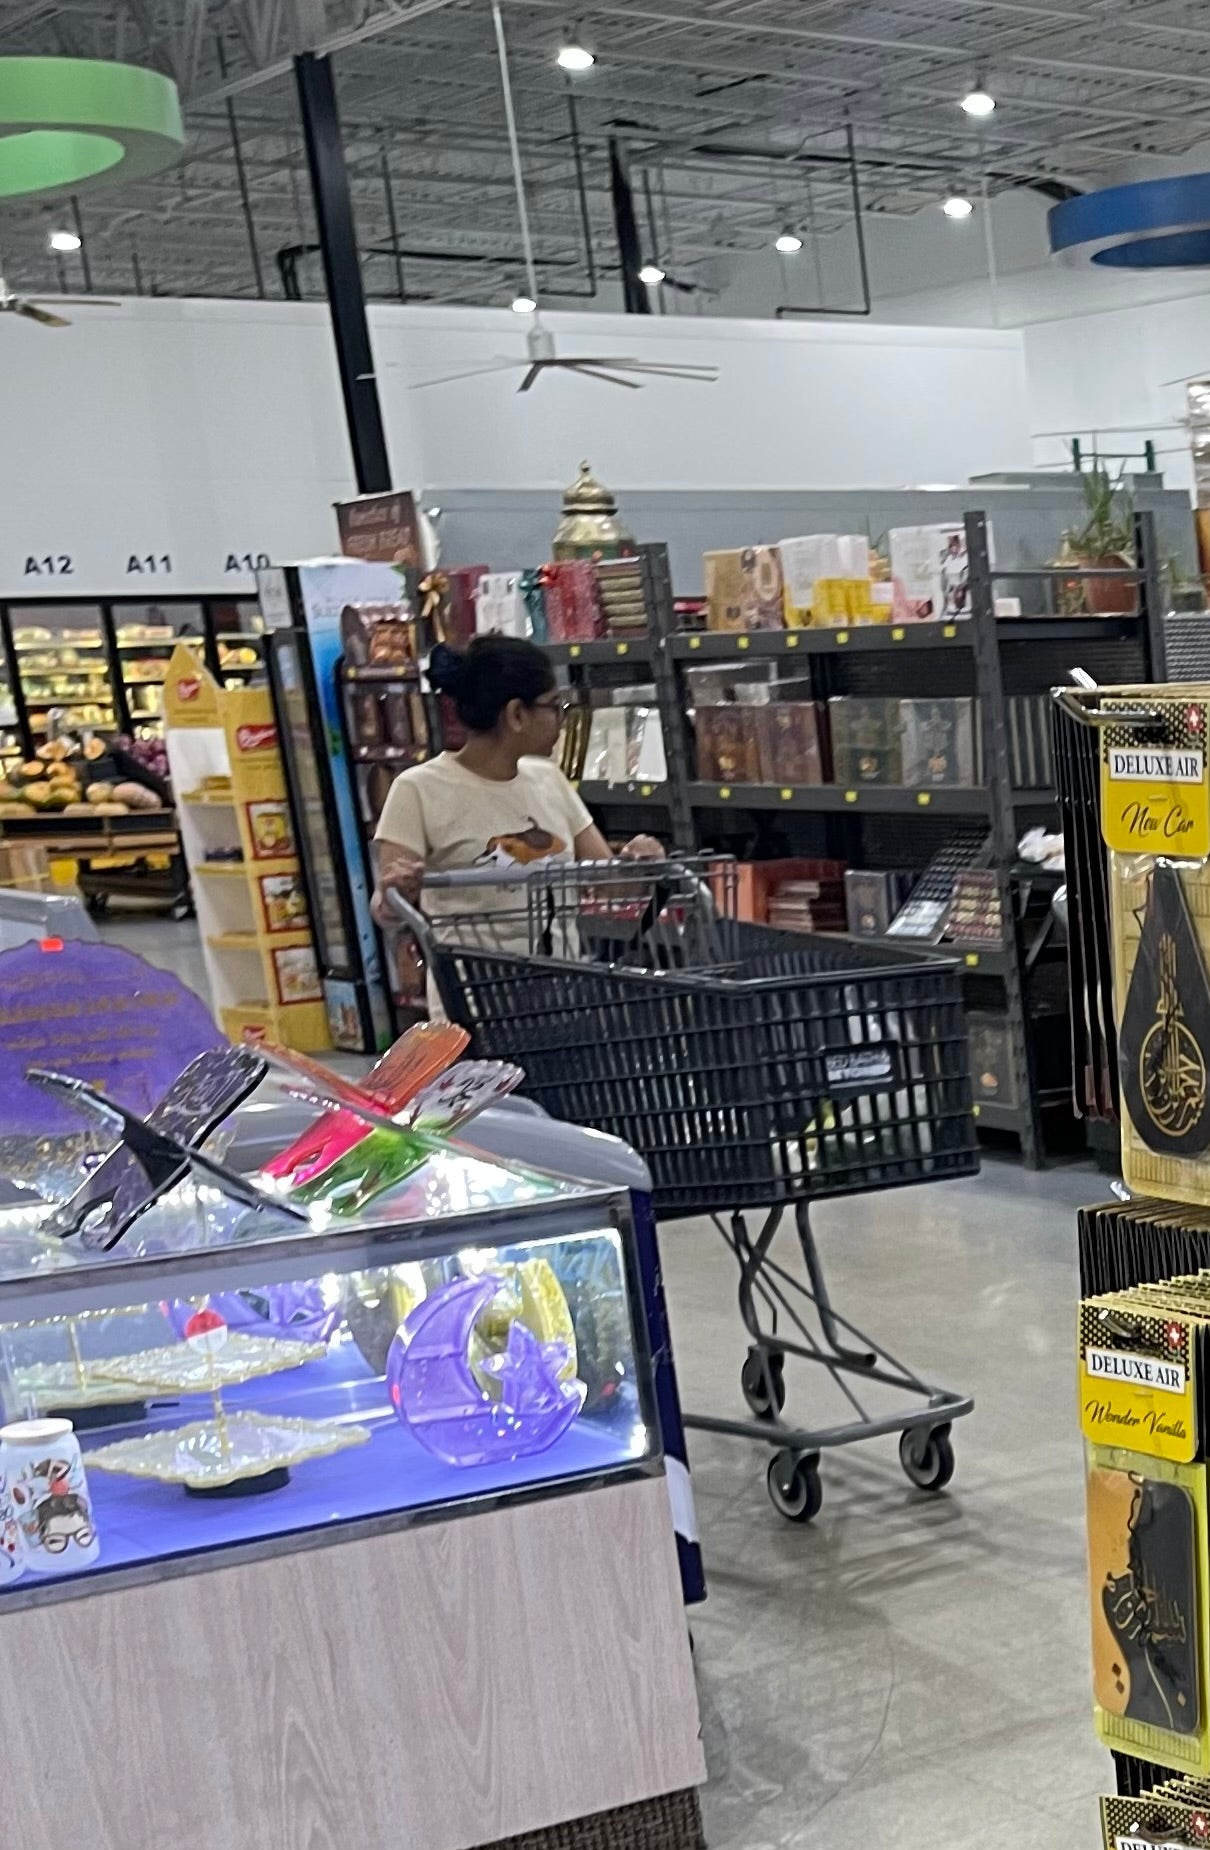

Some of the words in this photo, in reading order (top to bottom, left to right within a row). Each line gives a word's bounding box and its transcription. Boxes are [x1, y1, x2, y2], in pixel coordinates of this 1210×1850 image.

[24, 555, 74, 575] A12
[126, 554, 173, 574] A11
[225, 553, 271, 573] A10
[1114, 755, 1172, 776] DELUXE
[1176, 757, 1199, 777] AIR
[1121, 800, 1159, 838] New
[1163, 804, 1194, 837] Car
[1091, 1354, 1155, 1382] DELUXE
[1156, 1365, 1181, 1388] AIR
[1085, 1399, 1141, 1427] Wonder
[1142, 1411, 1186, 1439] Vanilla
